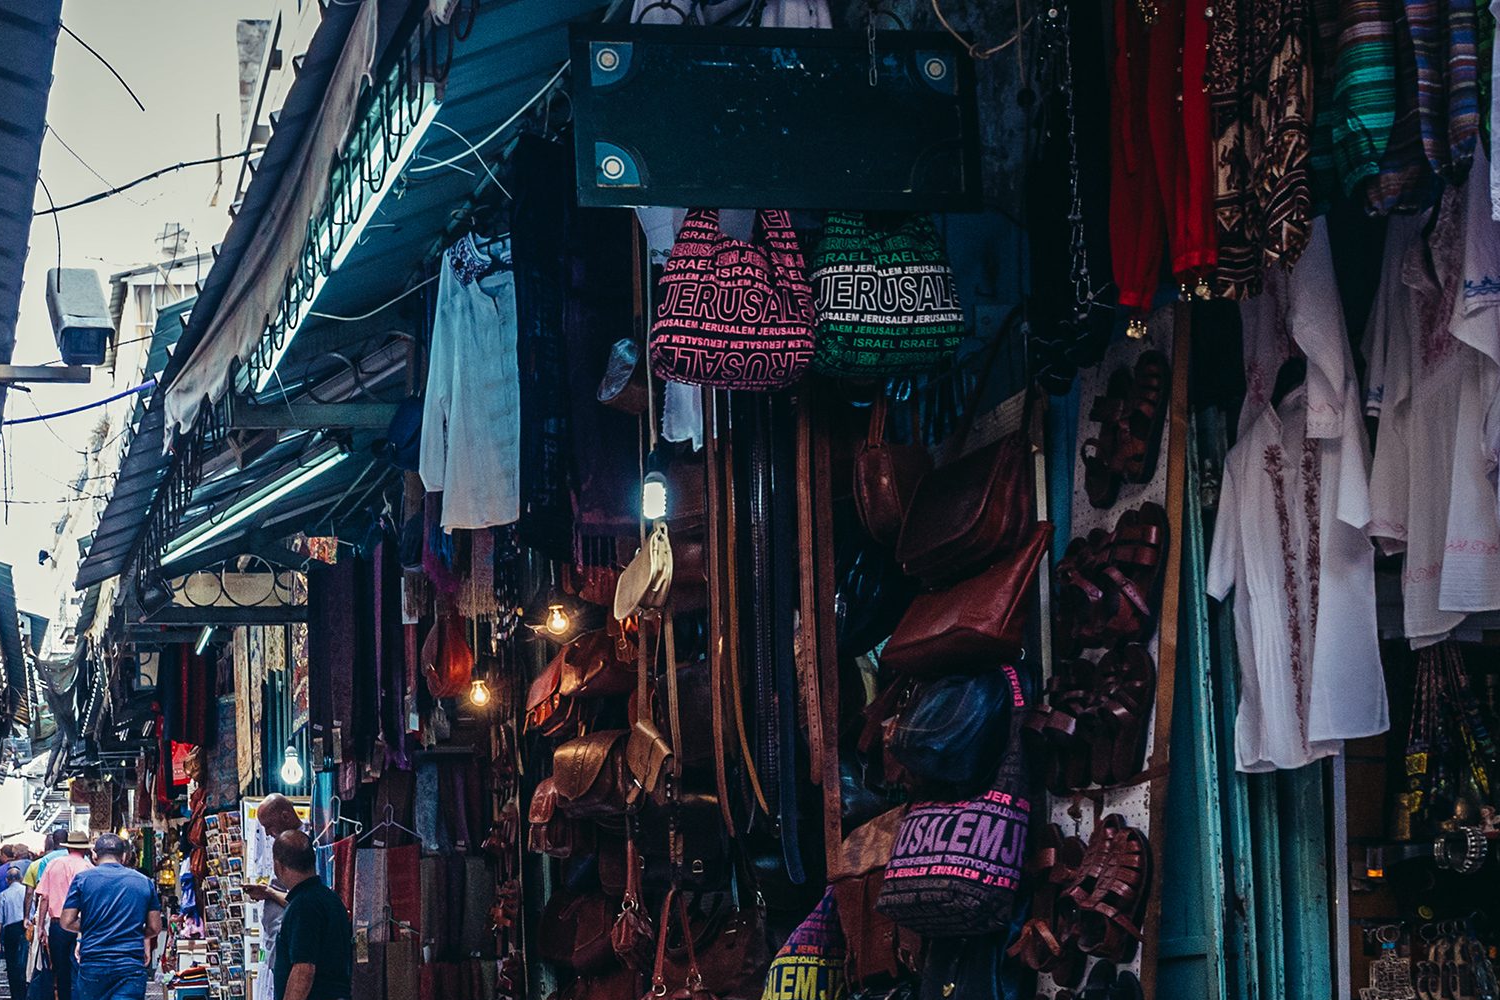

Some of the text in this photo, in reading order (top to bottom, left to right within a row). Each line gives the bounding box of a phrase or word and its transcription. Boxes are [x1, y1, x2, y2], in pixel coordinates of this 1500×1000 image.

[716, 266, 771, 285] ISRAEL
[860, 313, 914, 324] JERUSALEM
[700, 321, 756, 336] JERUSALEM
[757, 326, 807, 336] JERUSALEM
[854, 324, 909, 335] JERUSALEM
[671, 334, 729, 349] JERUSALEM
[730, 340, 786, 349] JERUSALEM
[853, 338, 896, 349] ISRAEL
[900, 338, 940, 349] ISRAEL
